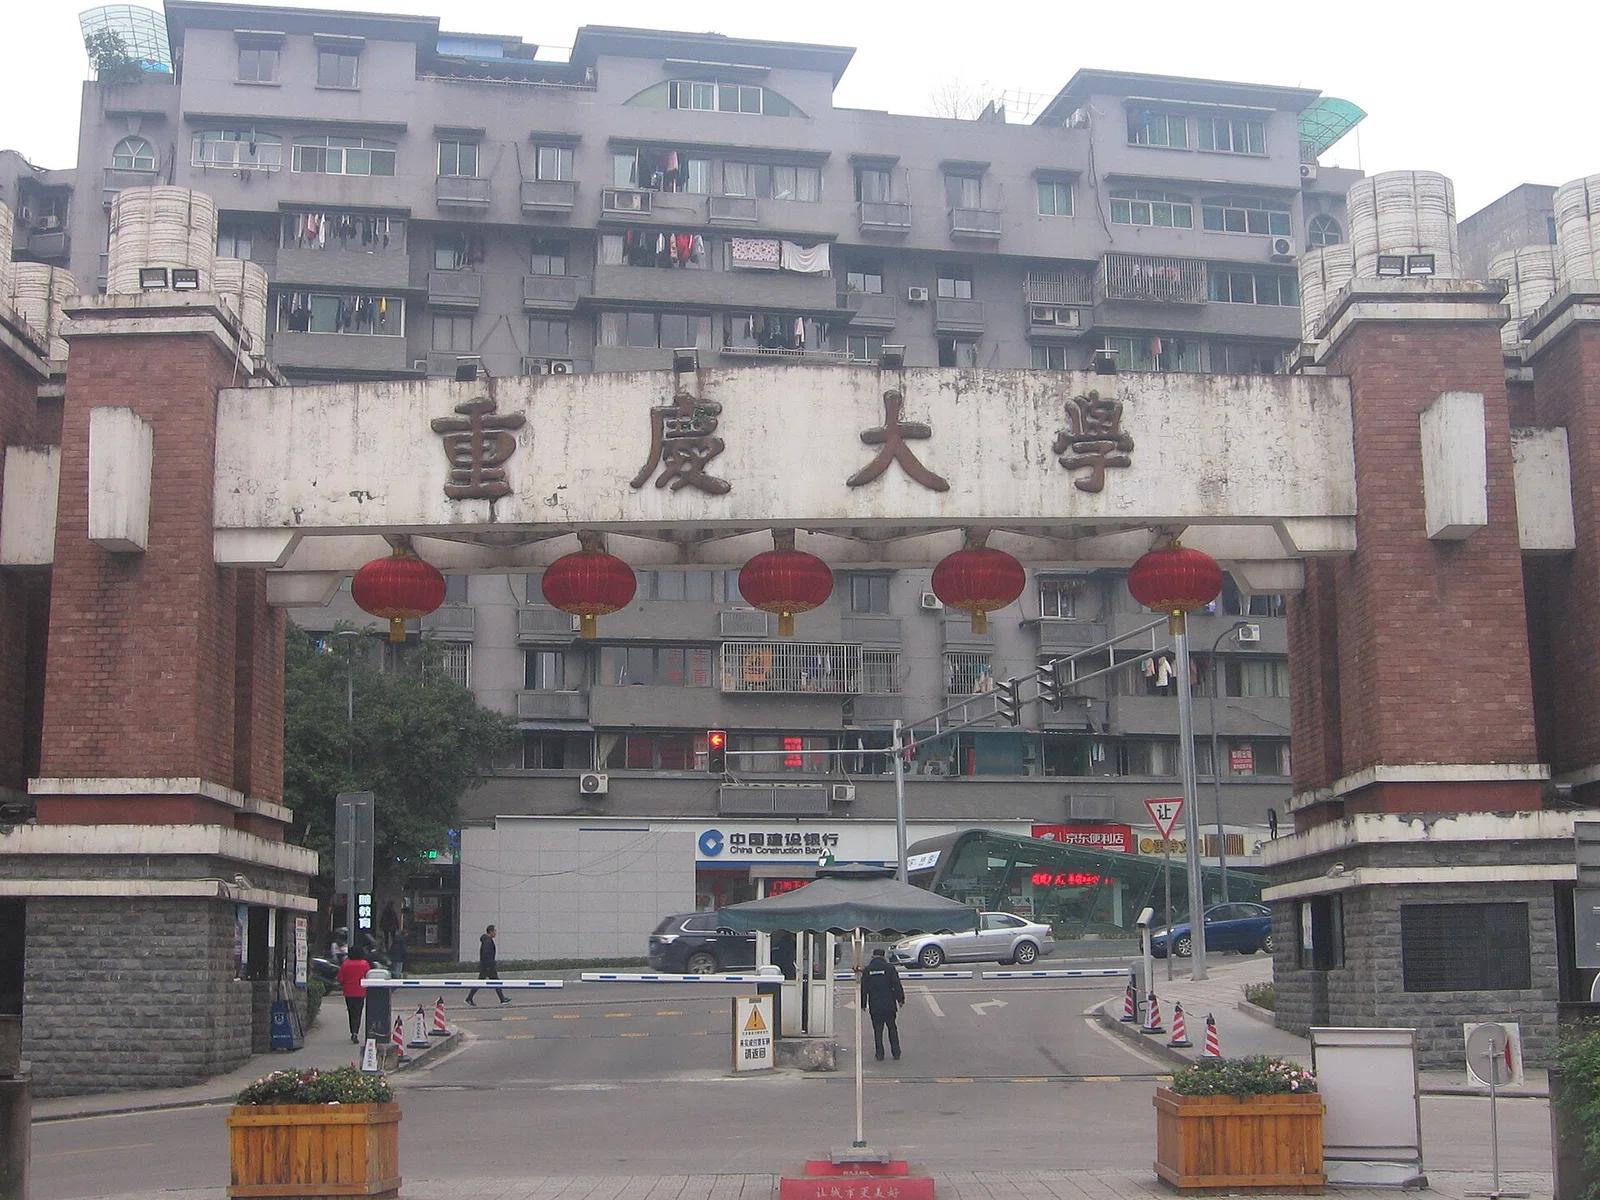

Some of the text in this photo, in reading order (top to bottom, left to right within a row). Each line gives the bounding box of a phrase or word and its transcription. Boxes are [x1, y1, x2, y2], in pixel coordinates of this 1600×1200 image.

[1157, 804, 1173, 820] 让
[730, 832, 839, 847] 中国建设银行
[1066, 832, 1125, 845] 京东便利店
[730, 846, 753, 854] China
[755, 846, 804, 854] Construction
[744, 1047, 766, 1060] 请返回
[816, 1186, 901, 1199] 让城市更美好
